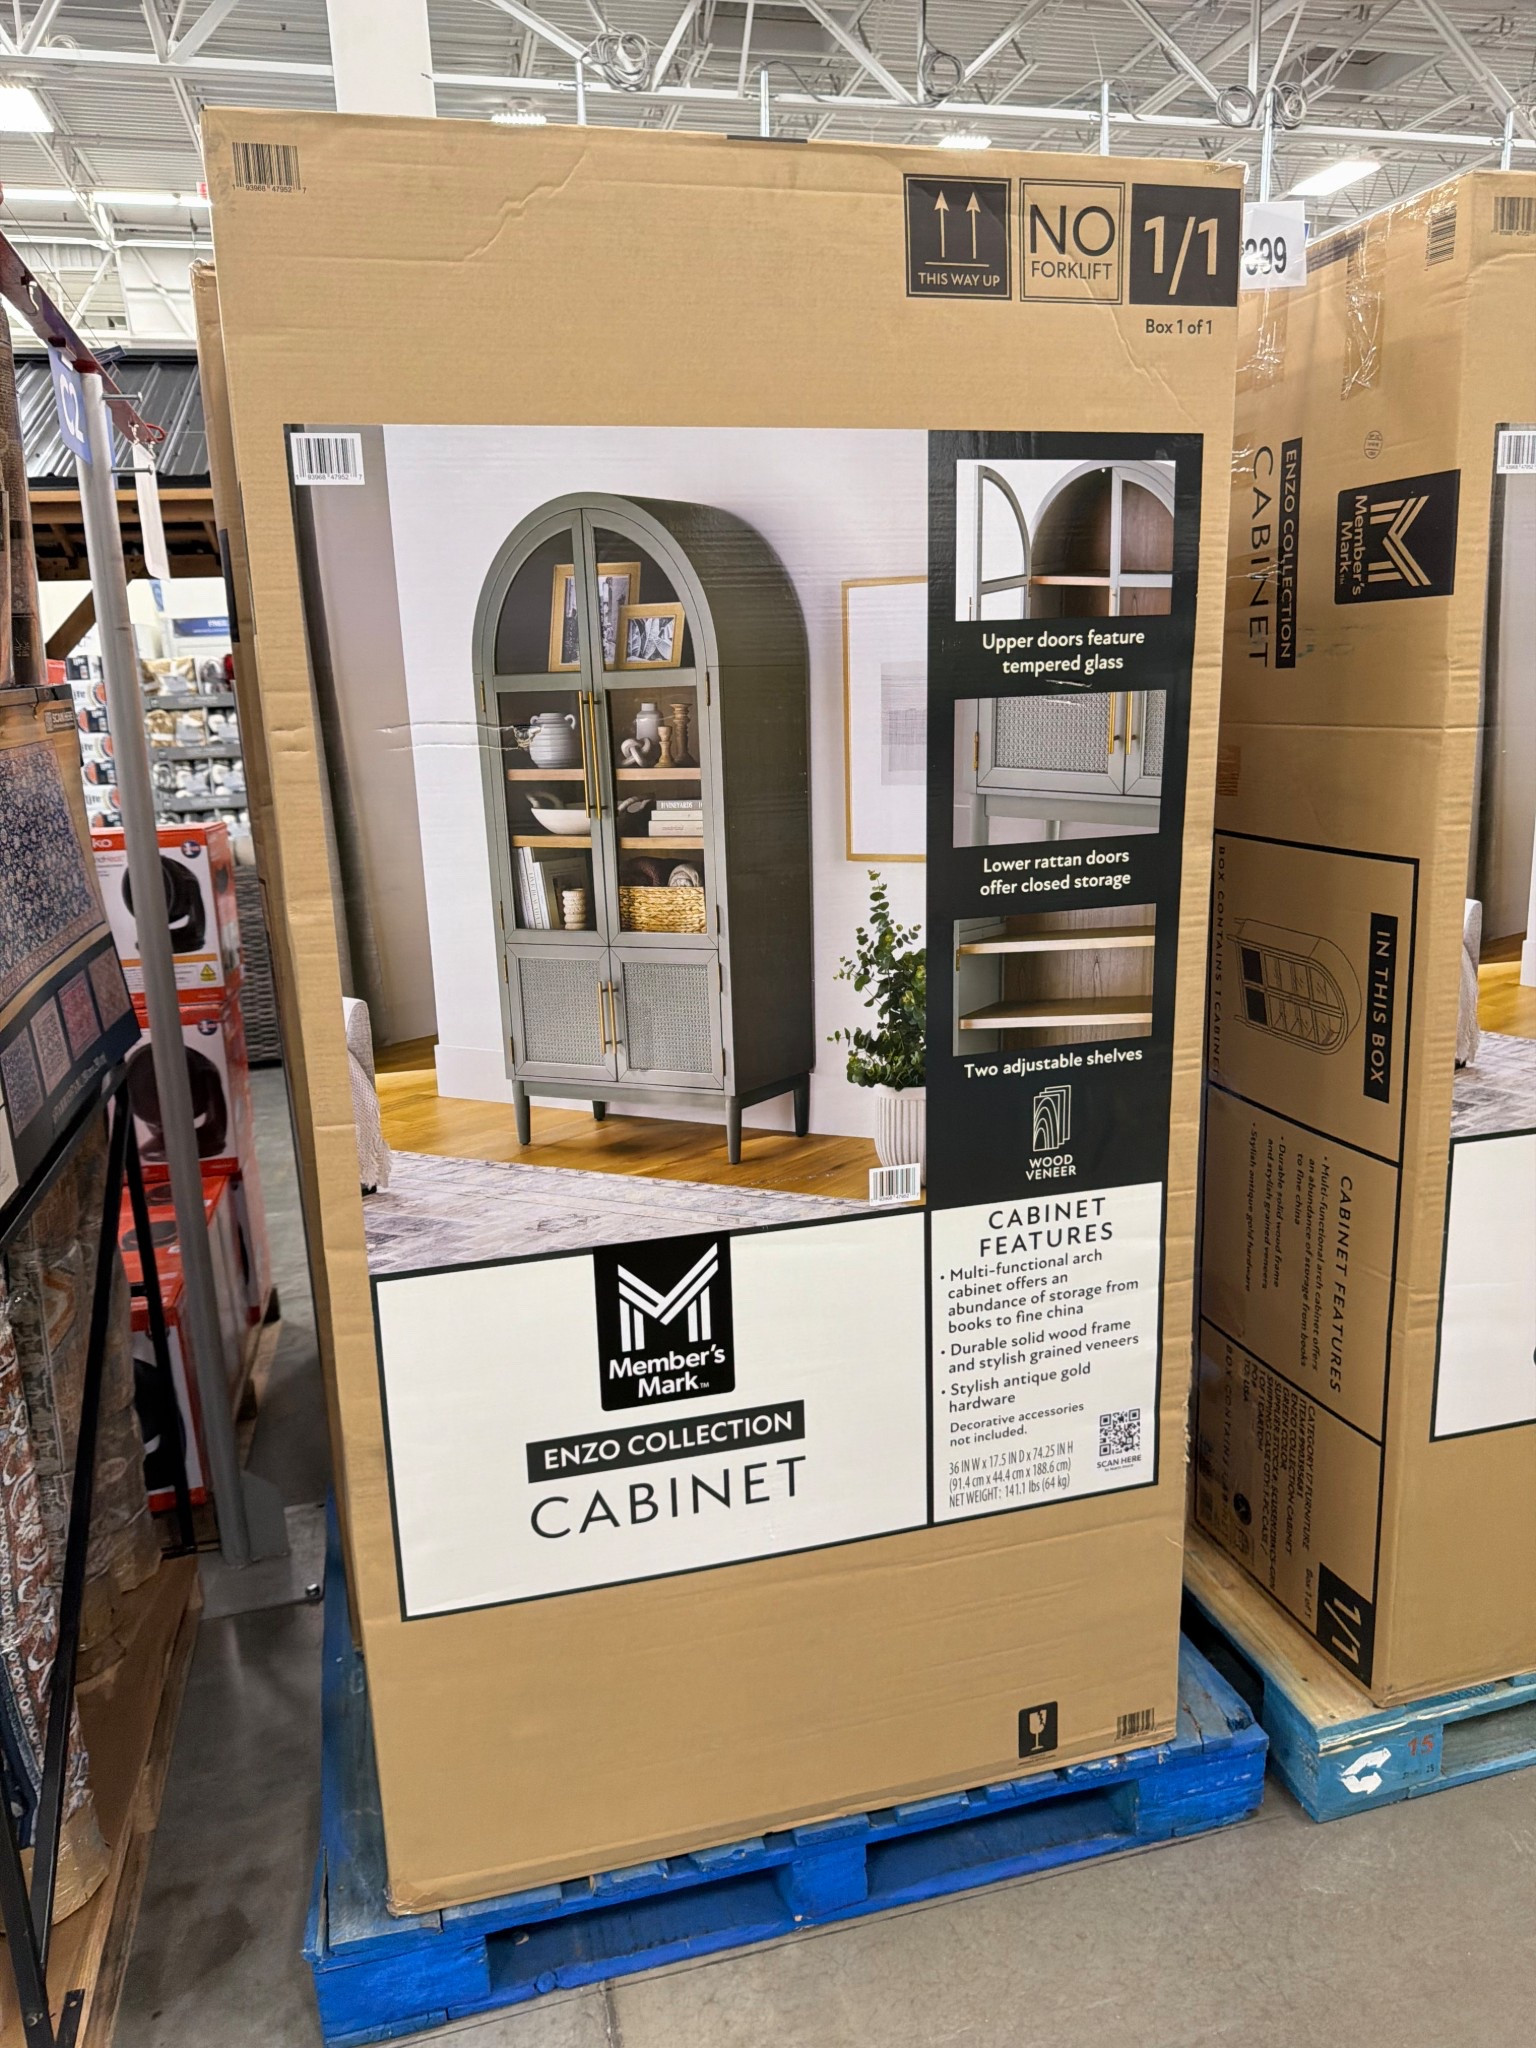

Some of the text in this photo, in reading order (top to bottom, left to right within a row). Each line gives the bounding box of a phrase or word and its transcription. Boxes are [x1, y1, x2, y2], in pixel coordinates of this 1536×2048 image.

[1030, 204, 1116, 257] NO
[1031, 261, 1113, 280] FORKLIFT
[1143, 215, 1218, 296] 1/1
[918, 272, 1000, 288] THIS WAY UP
[1146, 318, 1212, 335] Box 1 of 1
[1248, 446, 1273, 667] CABINET
[1280, 449, 1297, 658] ENZO COLLECTION
[982, 628, 1145, 654] Upper doors feature
[1002, 653, 1124, 678] tempered glass
[983, 850, 1130, 873] Lower rattan doors
[980, 873, 1131, 896] offer closed storage
[1215, 891, 1225, 982] CONTAINS
[1370, 930, 1391, 1084] IN THIS BOX
[964, 1048, 1143, 1079] Two adjustable shelves
[1025, 1165, 1077, 1181] VENEER
[1029, 1154, 1073, 1168] WOOD
[1264, 1163, 1274, 1199] stylish
[1294, 1153, 1304, 1225] to fine china
[988, 1197, 1106, 1230] CABINET
[1245, 1129, 1258, 1292] Stylish antique gold hardware
[1263, 1200, 1271, 1246] grained
[1272, 1144, 1286, 1288] Durable solid wood frame
[1316, 1163, 1330, 1263] Multi-functional
[980, 1222, 1113, 1257] FEATURES
[950, 1249, 1102, 1282] Multi-functional arch
[1300, 1158, 1316, 1367] an abundance of storage from books
[948, 1274, 1068, 1299] cabinet offers an
[948, 1279, 1139, 1317] abundance of storage from
[1329, 1175, 1353, 1392] CABINET FEATURES
[948, 1303, 1084, 1334] books to fine china
[1313, 1291, 1323, 1335] cabinet
[949, 1334, 1139, 1374] and stylish grained veneers
[951, 1320, 1131, 1356] Durable solid wood frame
[1311, 1337, 1321, 1371] offers
[609, 1344, 726, 1380] Member's
[951, 1361, 1091, 1397] Stylish antique gold
[949, 1393, 1016, 1413] hardware
[950, 1402, 1084, 1433] Decorative accessories
[544, 1410, 792, 1470] ENZO COLLECTION
[950, 1424, 1028, 1447] not included.
[1279, 1386, 1290, 1471] GREEN COLOR
[949, 1440, 1074, 1476] 36 IN W x 17.5 IN D x 74.25 IN H
[949, 1457, 1072, 1493] (91.4 cm x 44.4 cm x 188.6 cm)
[1096, 1458, 1120, 1469] SCAN
[1120, 1454, 1142, 1464] HERE
[1285, 1392, 1299, 1557] ENZO COLLECTION CABINET
[949, 1473, 1070, 1508] NET WEIGHT: 141.1 lbs (64 kg)
[1302, 1405, 1316, 1552] CATEGORY FURNITURE
[530, 1455, 806, 1539] CABINET
[1324, 1597, 1362, 1664] 1/1
